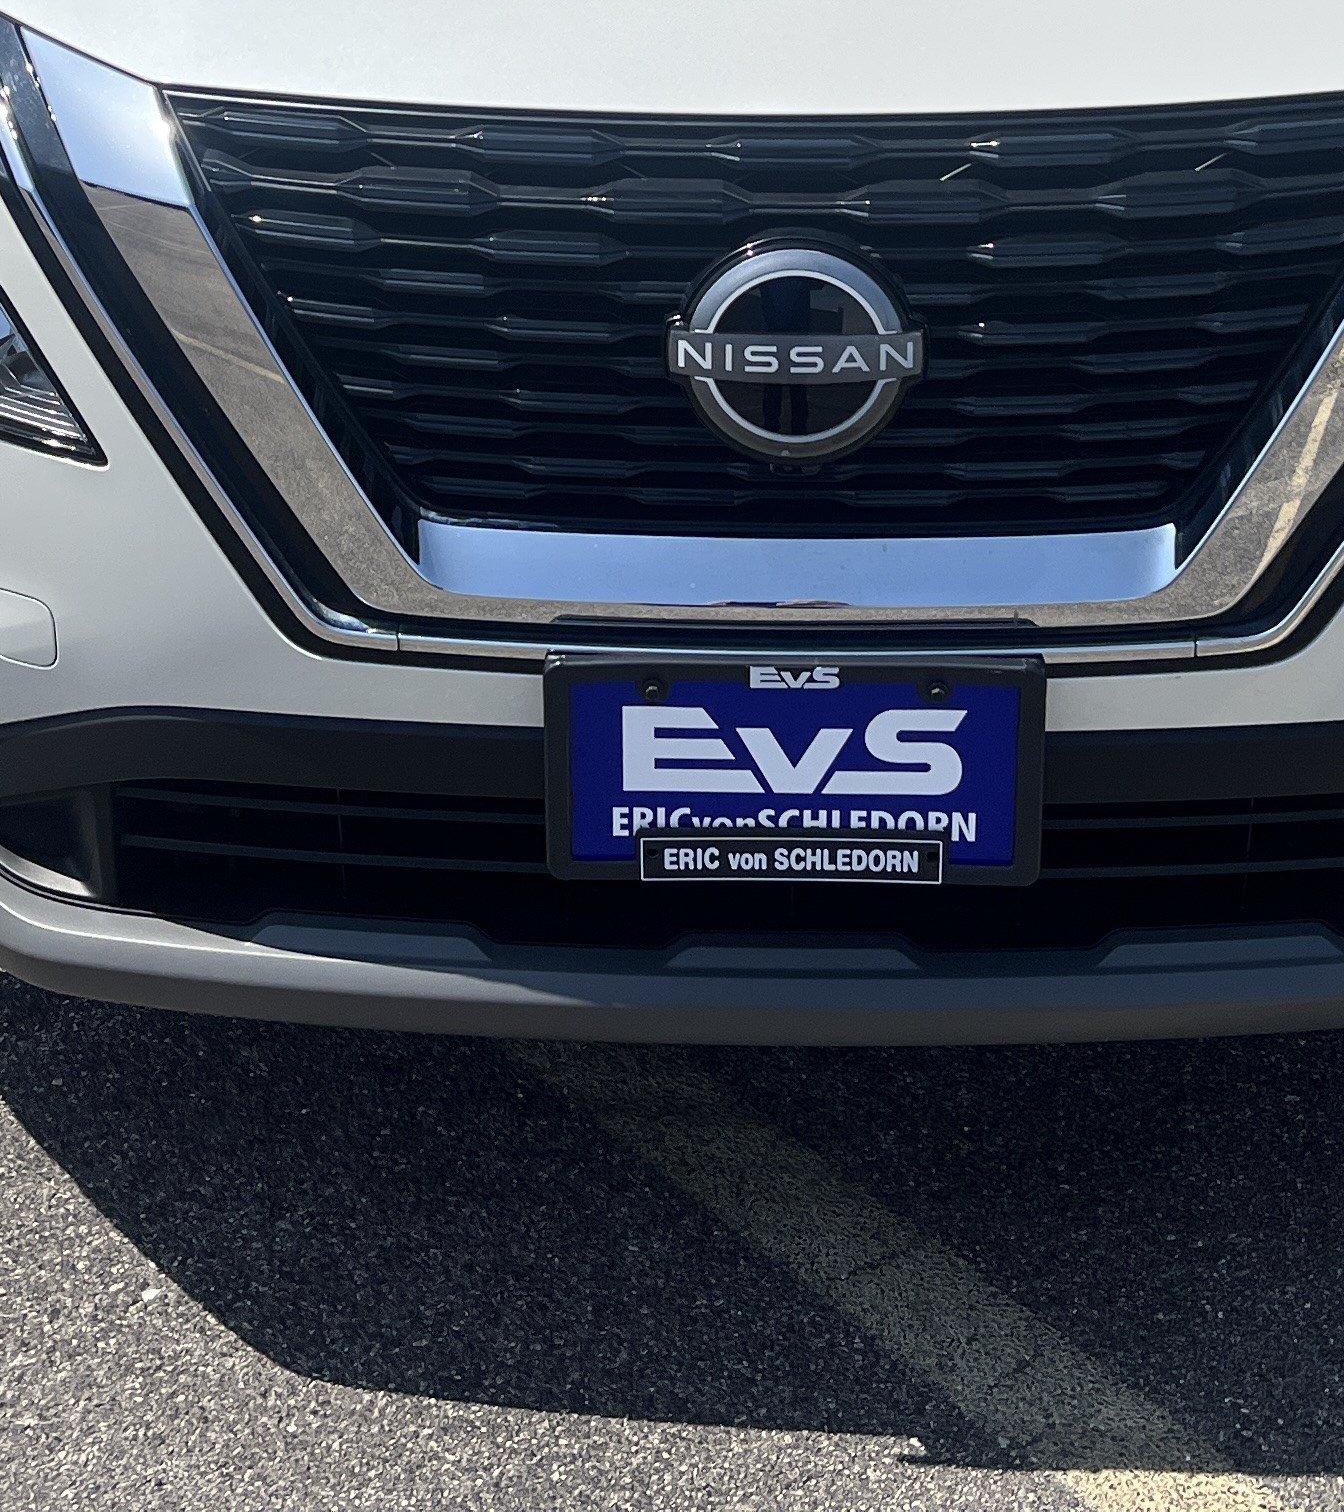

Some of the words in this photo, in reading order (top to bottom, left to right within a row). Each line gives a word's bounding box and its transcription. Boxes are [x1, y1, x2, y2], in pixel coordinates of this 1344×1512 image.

[677, 340, 914, 374] NISSAN
[749, 665, 841, 690] EvS
[622, 705, 968, 796] EvS
[664, 847, 720, 871] ERIC
[727, 851, 768, 871] von
[774, 847, 919, 874] SCHLEDORN
